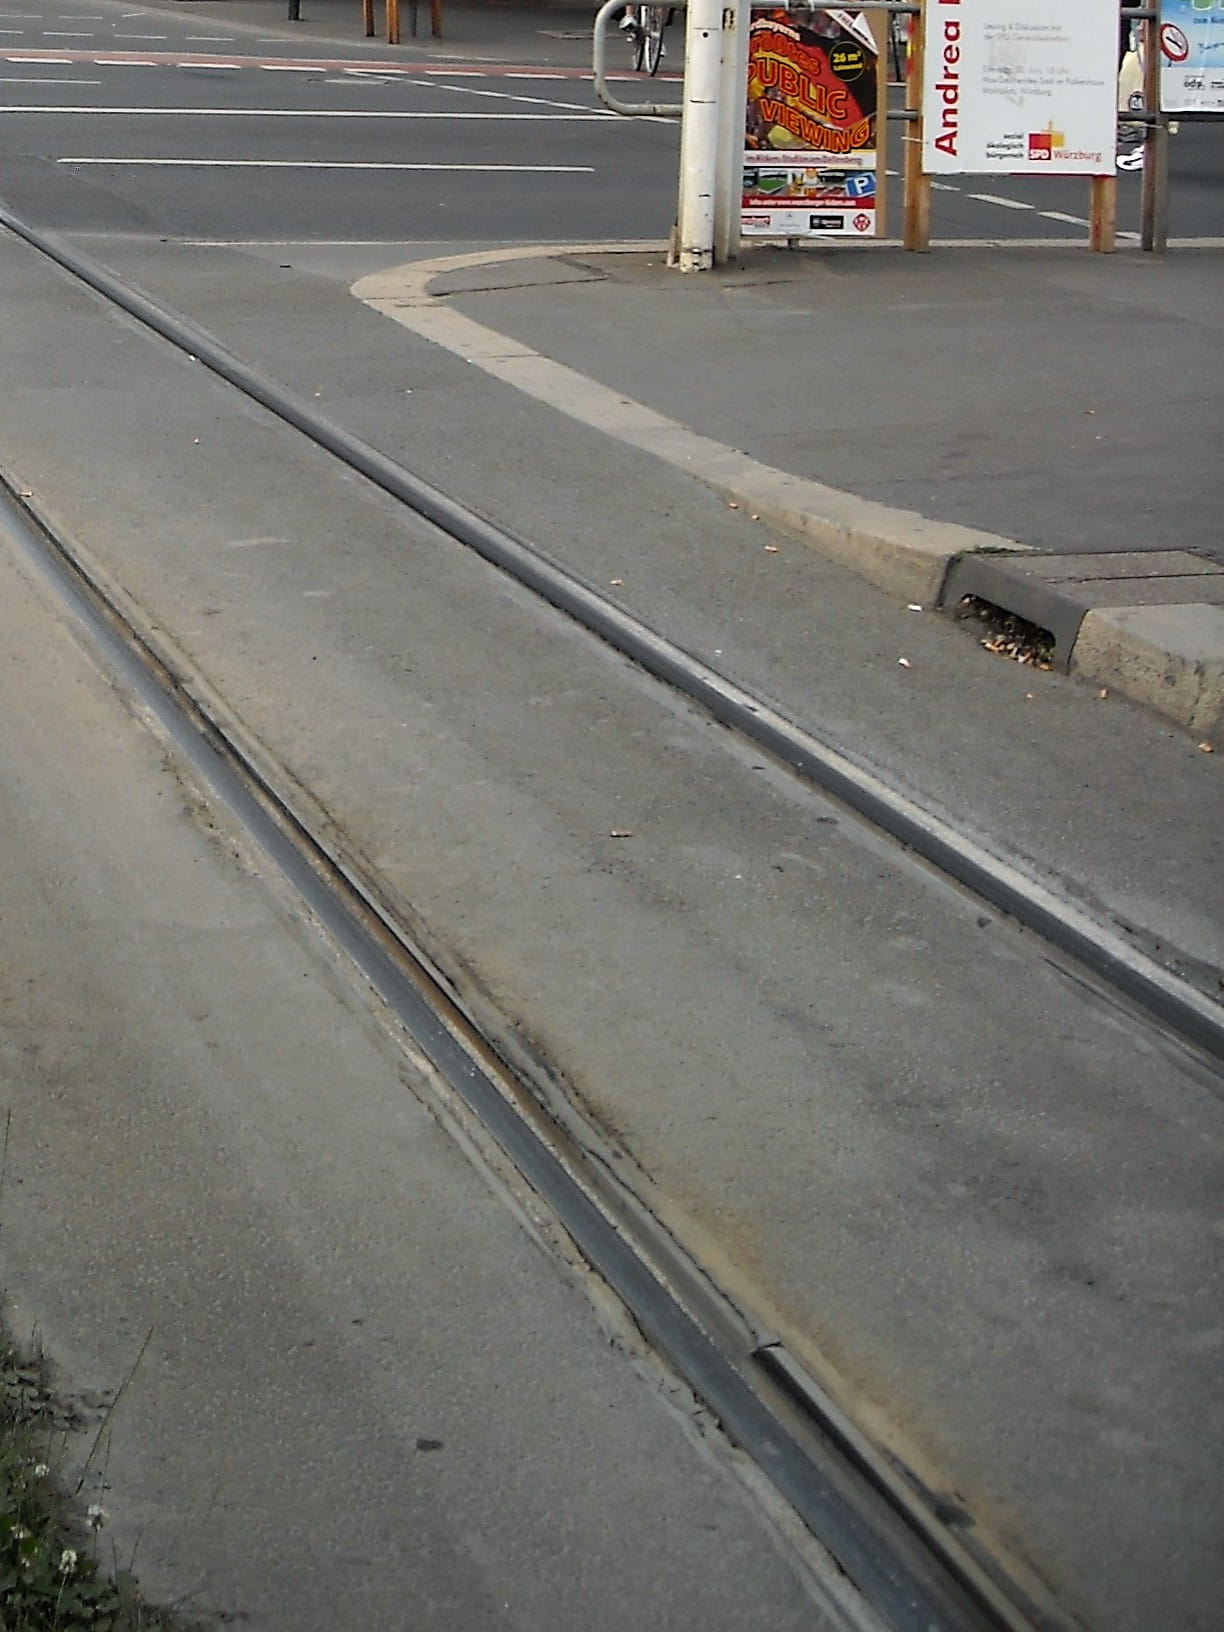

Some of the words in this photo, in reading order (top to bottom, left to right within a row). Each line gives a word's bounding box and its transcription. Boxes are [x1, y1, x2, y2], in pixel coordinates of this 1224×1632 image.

[934, 20, 961, 156] Andrea
[760, 99, 871, 153] VIEWING
[1030, 149, 1050, 160] SPD
[1053, 150, 1102, 162] Würzburg
